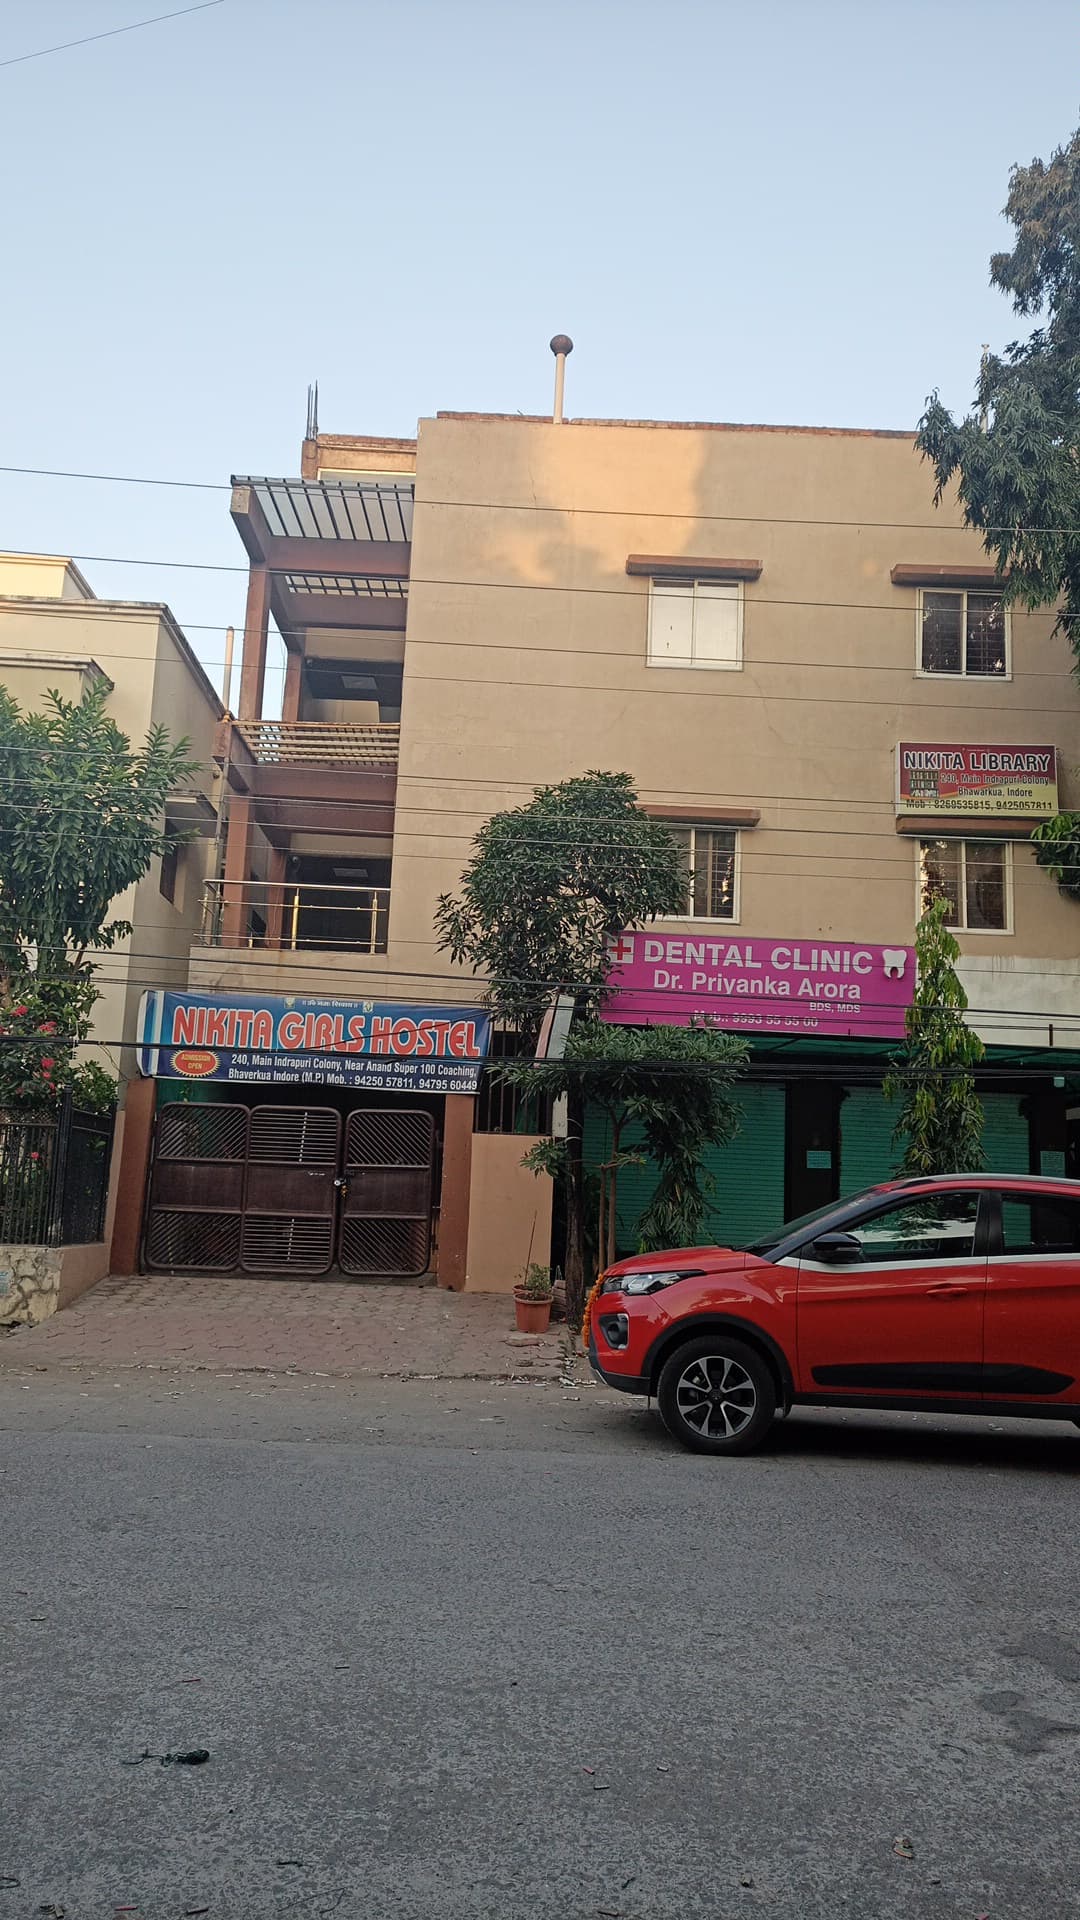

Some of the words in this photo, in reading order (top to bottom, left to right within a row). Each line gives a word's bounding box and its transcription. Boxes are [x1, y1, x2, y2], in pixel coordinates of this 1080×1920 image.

[904, 751, 964, 770] NIKITA
[970, 752, 1050, 772] LIBRARY
[940, 774, 958, 785] 240,
[961, 774, 981, 784] Main
[983, 774, 1019, 786] Indrapuri
[1021, 775, 1049, 786] Colony
[1007, 787, 1033, 797] Indore
[644, 940, 762, 969] DENTAL
[770, 947, 873, 974] CLINIC
[653, 970, 683, 990] Dr.
[692, 972, 790, 996] Priyanka
[797, 979, 861, 1000] Arora
[809, 1001, 834, 1014] BDS,
[837, 1003, 861, 1014] MDS
[172, 1005, 273, 1049] NIKITA
[277, 1011, 365, 1052] GIRLS
[370, 1017, 480, 1058] HOSTEL
[231, 1054, 249, 1066] 240,
[252, 1055, 272, 1066] Main
[274, 1056, 311, 1069] Indrapuri
[313, 1058, 342, 1071] Colony,
[345, 1059, 363, 1071] Near
[366, 1061, 392, 1072] Anand
[394, 1062, 418, 1075] Super
[420, 1064, 435, 1075] 100
[438, 1064, 477, 1077] Coaching,
[228, 1068, 271, 1081] Bhaverkua
[273, 1070, 299, 1082] Indore
[301, 1072, 325, 1084] (M.P.)
[354, 1075, 383, 1086] 94250
[386, 1076, 416, 1089] 57811,
[419, 1078, 448, 1089] 94795
[450, 1079, 478, 1090] 60449
